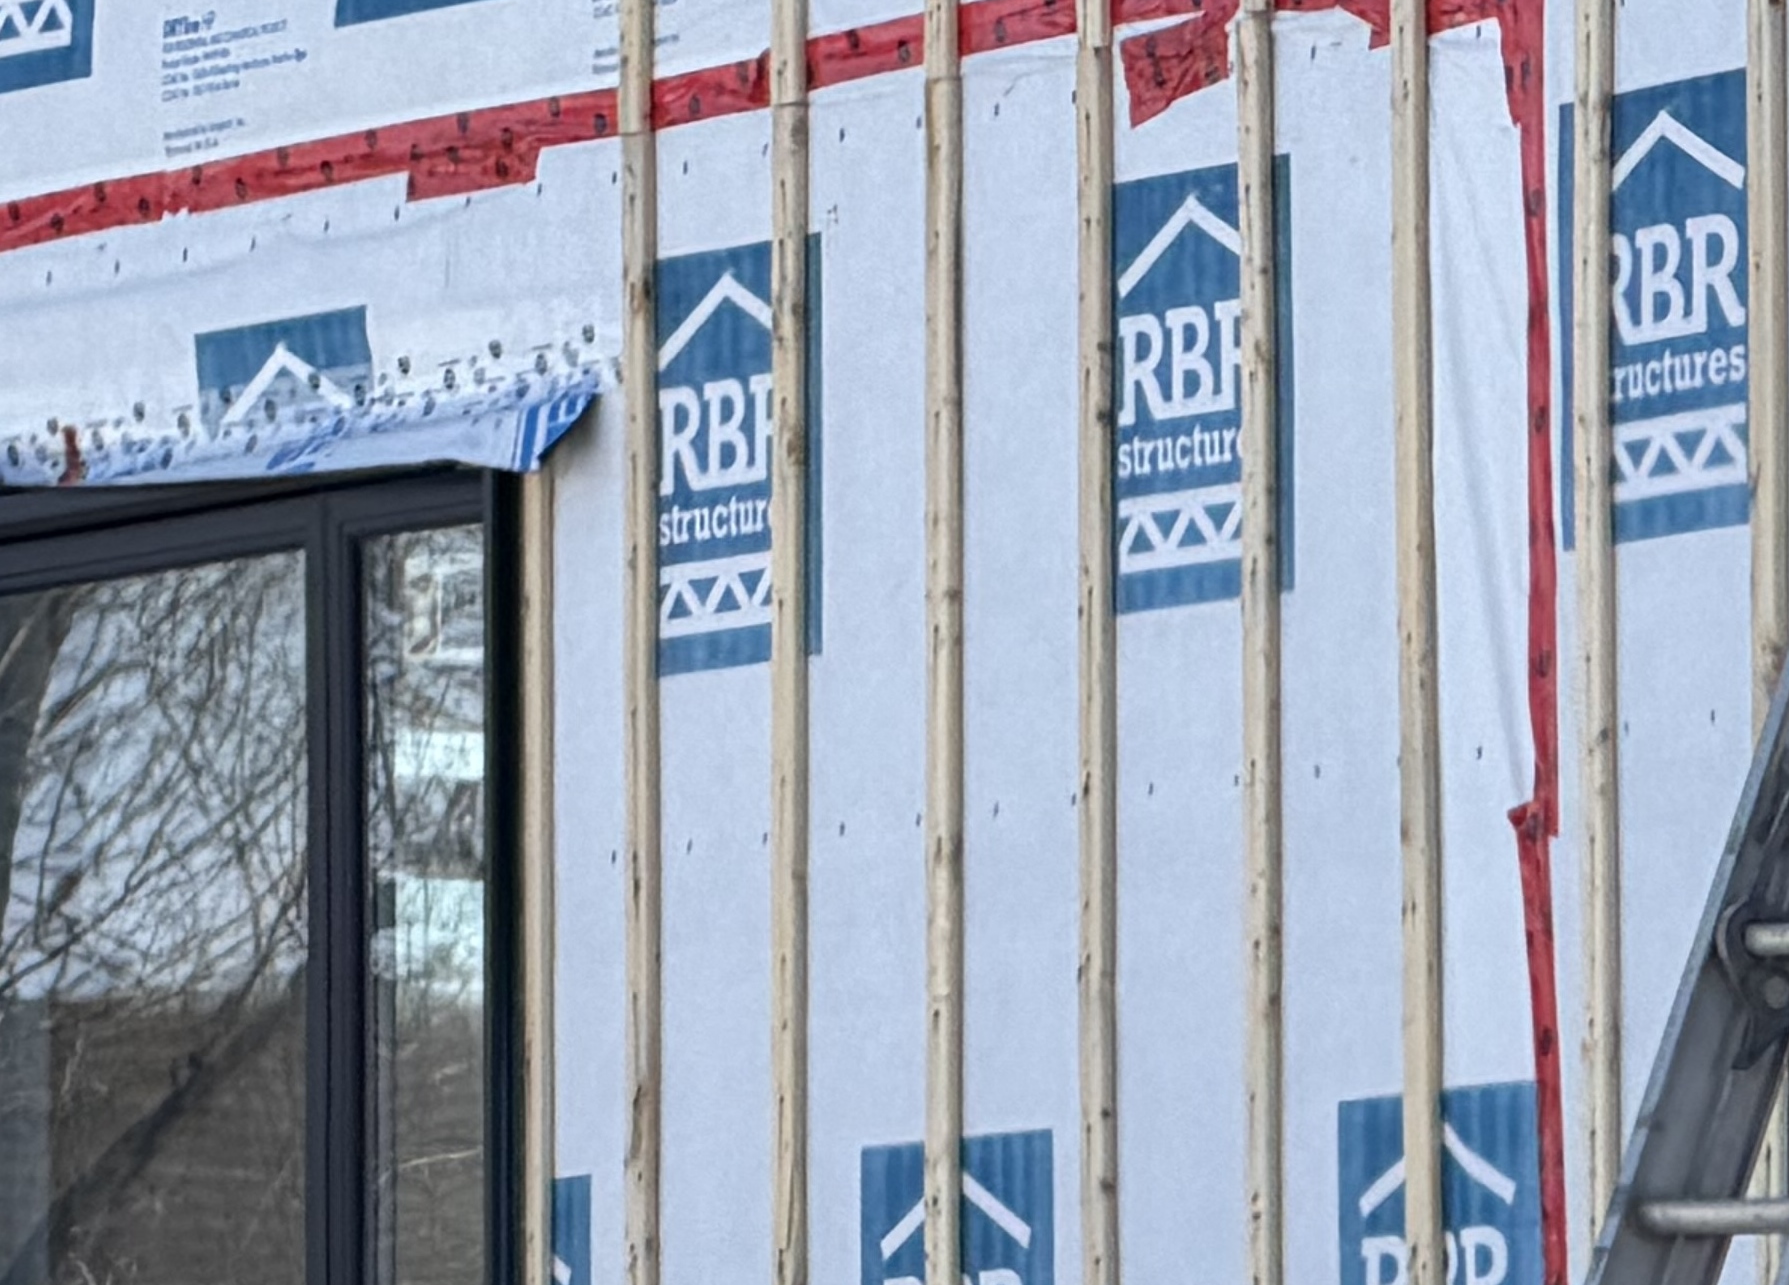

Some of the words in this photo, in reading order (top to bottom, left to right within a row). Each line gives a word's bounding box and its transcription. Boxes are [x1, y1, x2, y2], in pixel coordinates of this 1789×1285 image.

[1612, 344, 1747, 400] ructures
[1117, 425, 1243, 477] structur
[659, 494, 774, 547] structur
